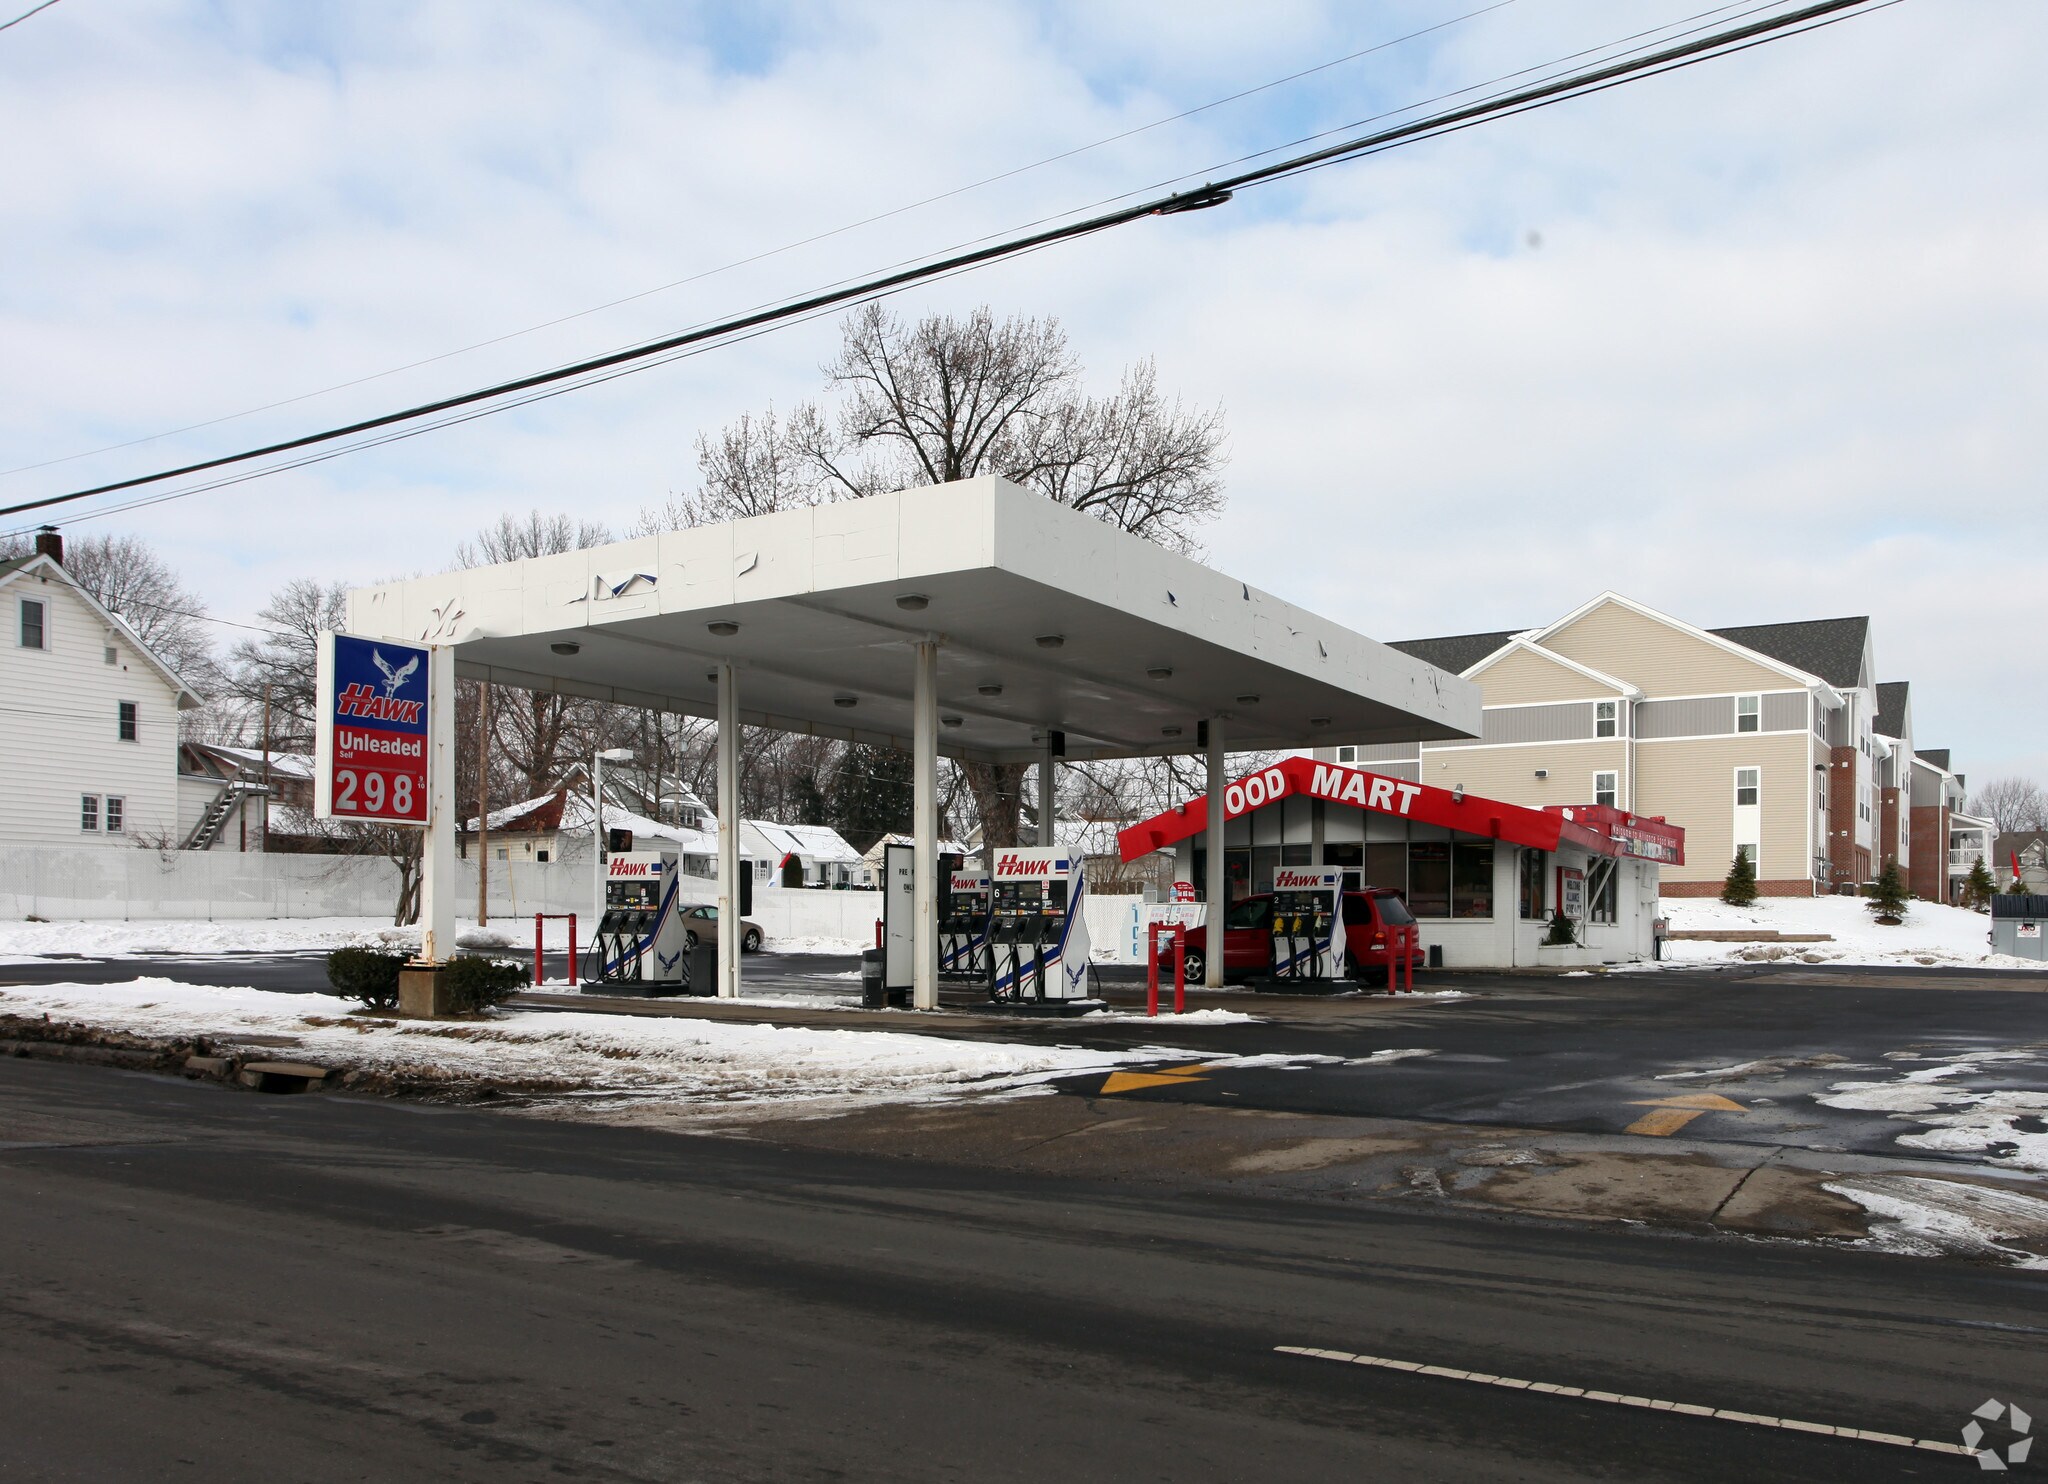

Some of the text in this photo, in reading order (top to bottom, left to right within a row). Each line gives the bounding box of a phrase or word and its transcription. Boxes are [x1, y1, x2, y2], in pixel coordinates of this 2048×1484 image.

[338, 683, 424, 723] HAWK
[339, 731, 421, 757] Unleaded
[335, 769, 412, 814] 298
[1225, 764, 1422, 815] OOD MART
[610, 858, 648, 875] HAWK
[898, 868, 908, 876] PRE
[997, 854, 1051, 875] HAWK
[1276, 871, 1321, 887] HAWK
[994, 889, 1000, 898] 6
